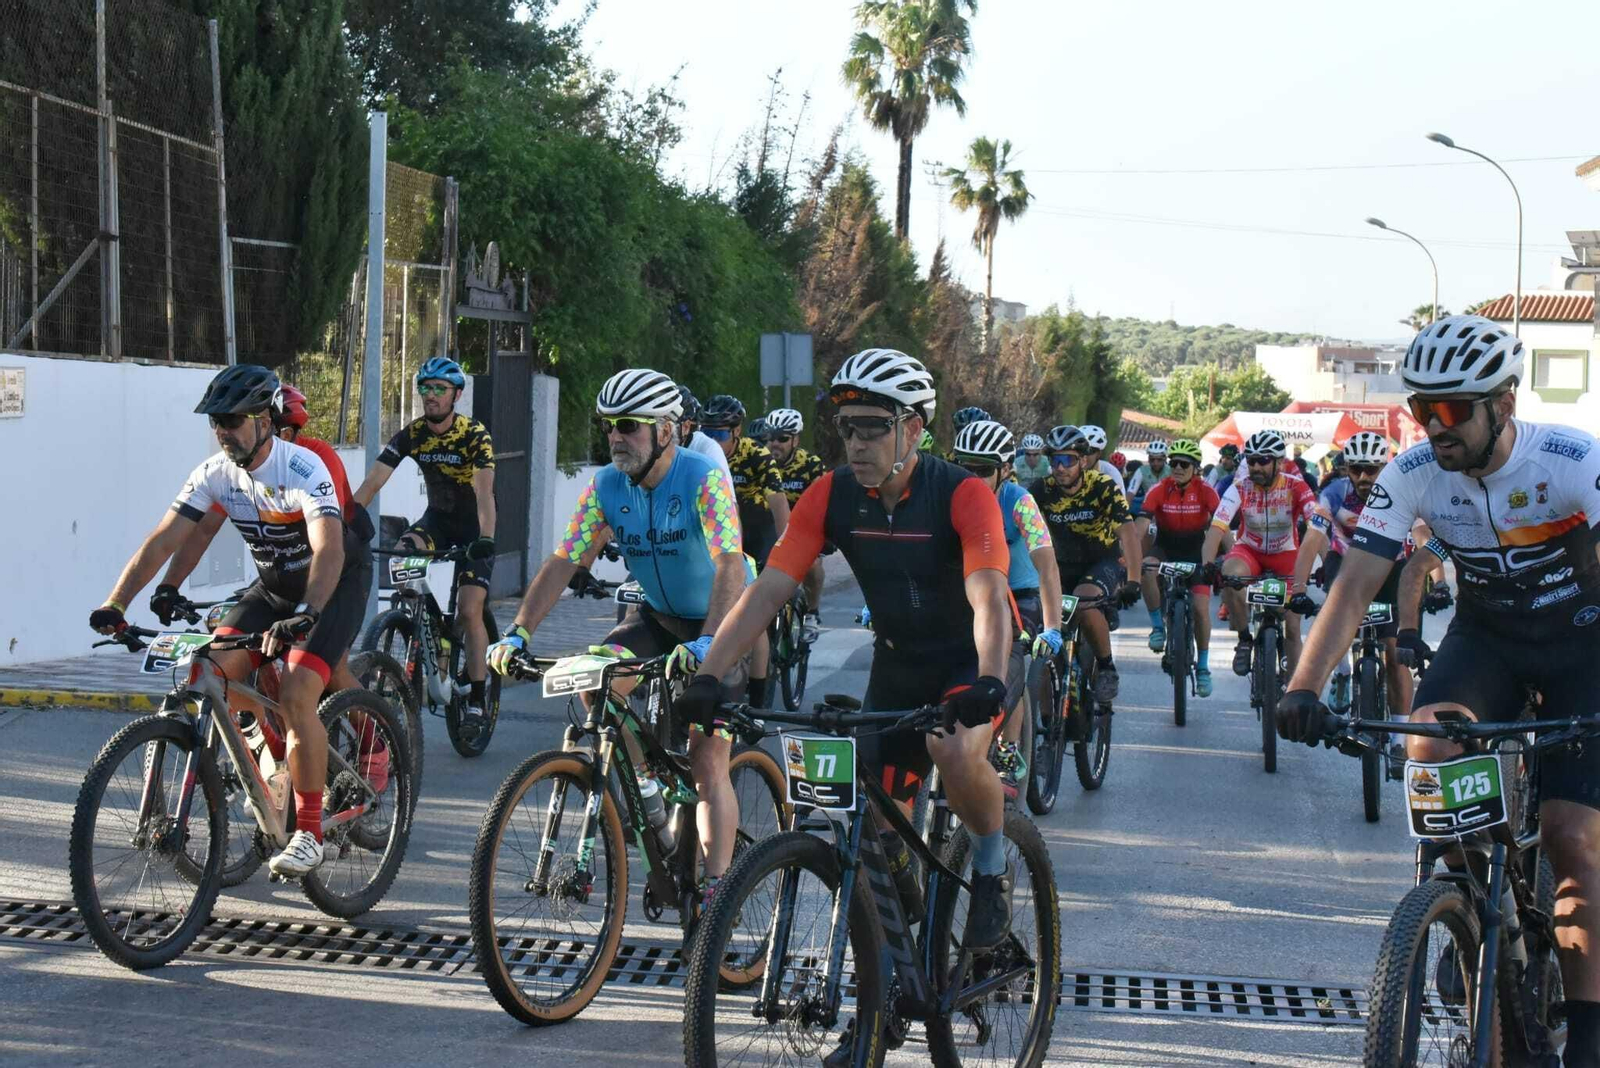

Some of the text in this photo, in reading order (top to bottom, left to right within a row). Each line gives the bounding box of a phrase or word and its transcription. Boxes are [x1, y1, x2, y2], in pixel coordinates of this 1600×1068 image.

[1261, 417, 1313, 429] TOYOTA
[617, 525, 641, 546] Los
[1268, 583, 1281, 593] 25
[814, 754, 837, 778] 77
[1448, 771, 1492, 803] 125
